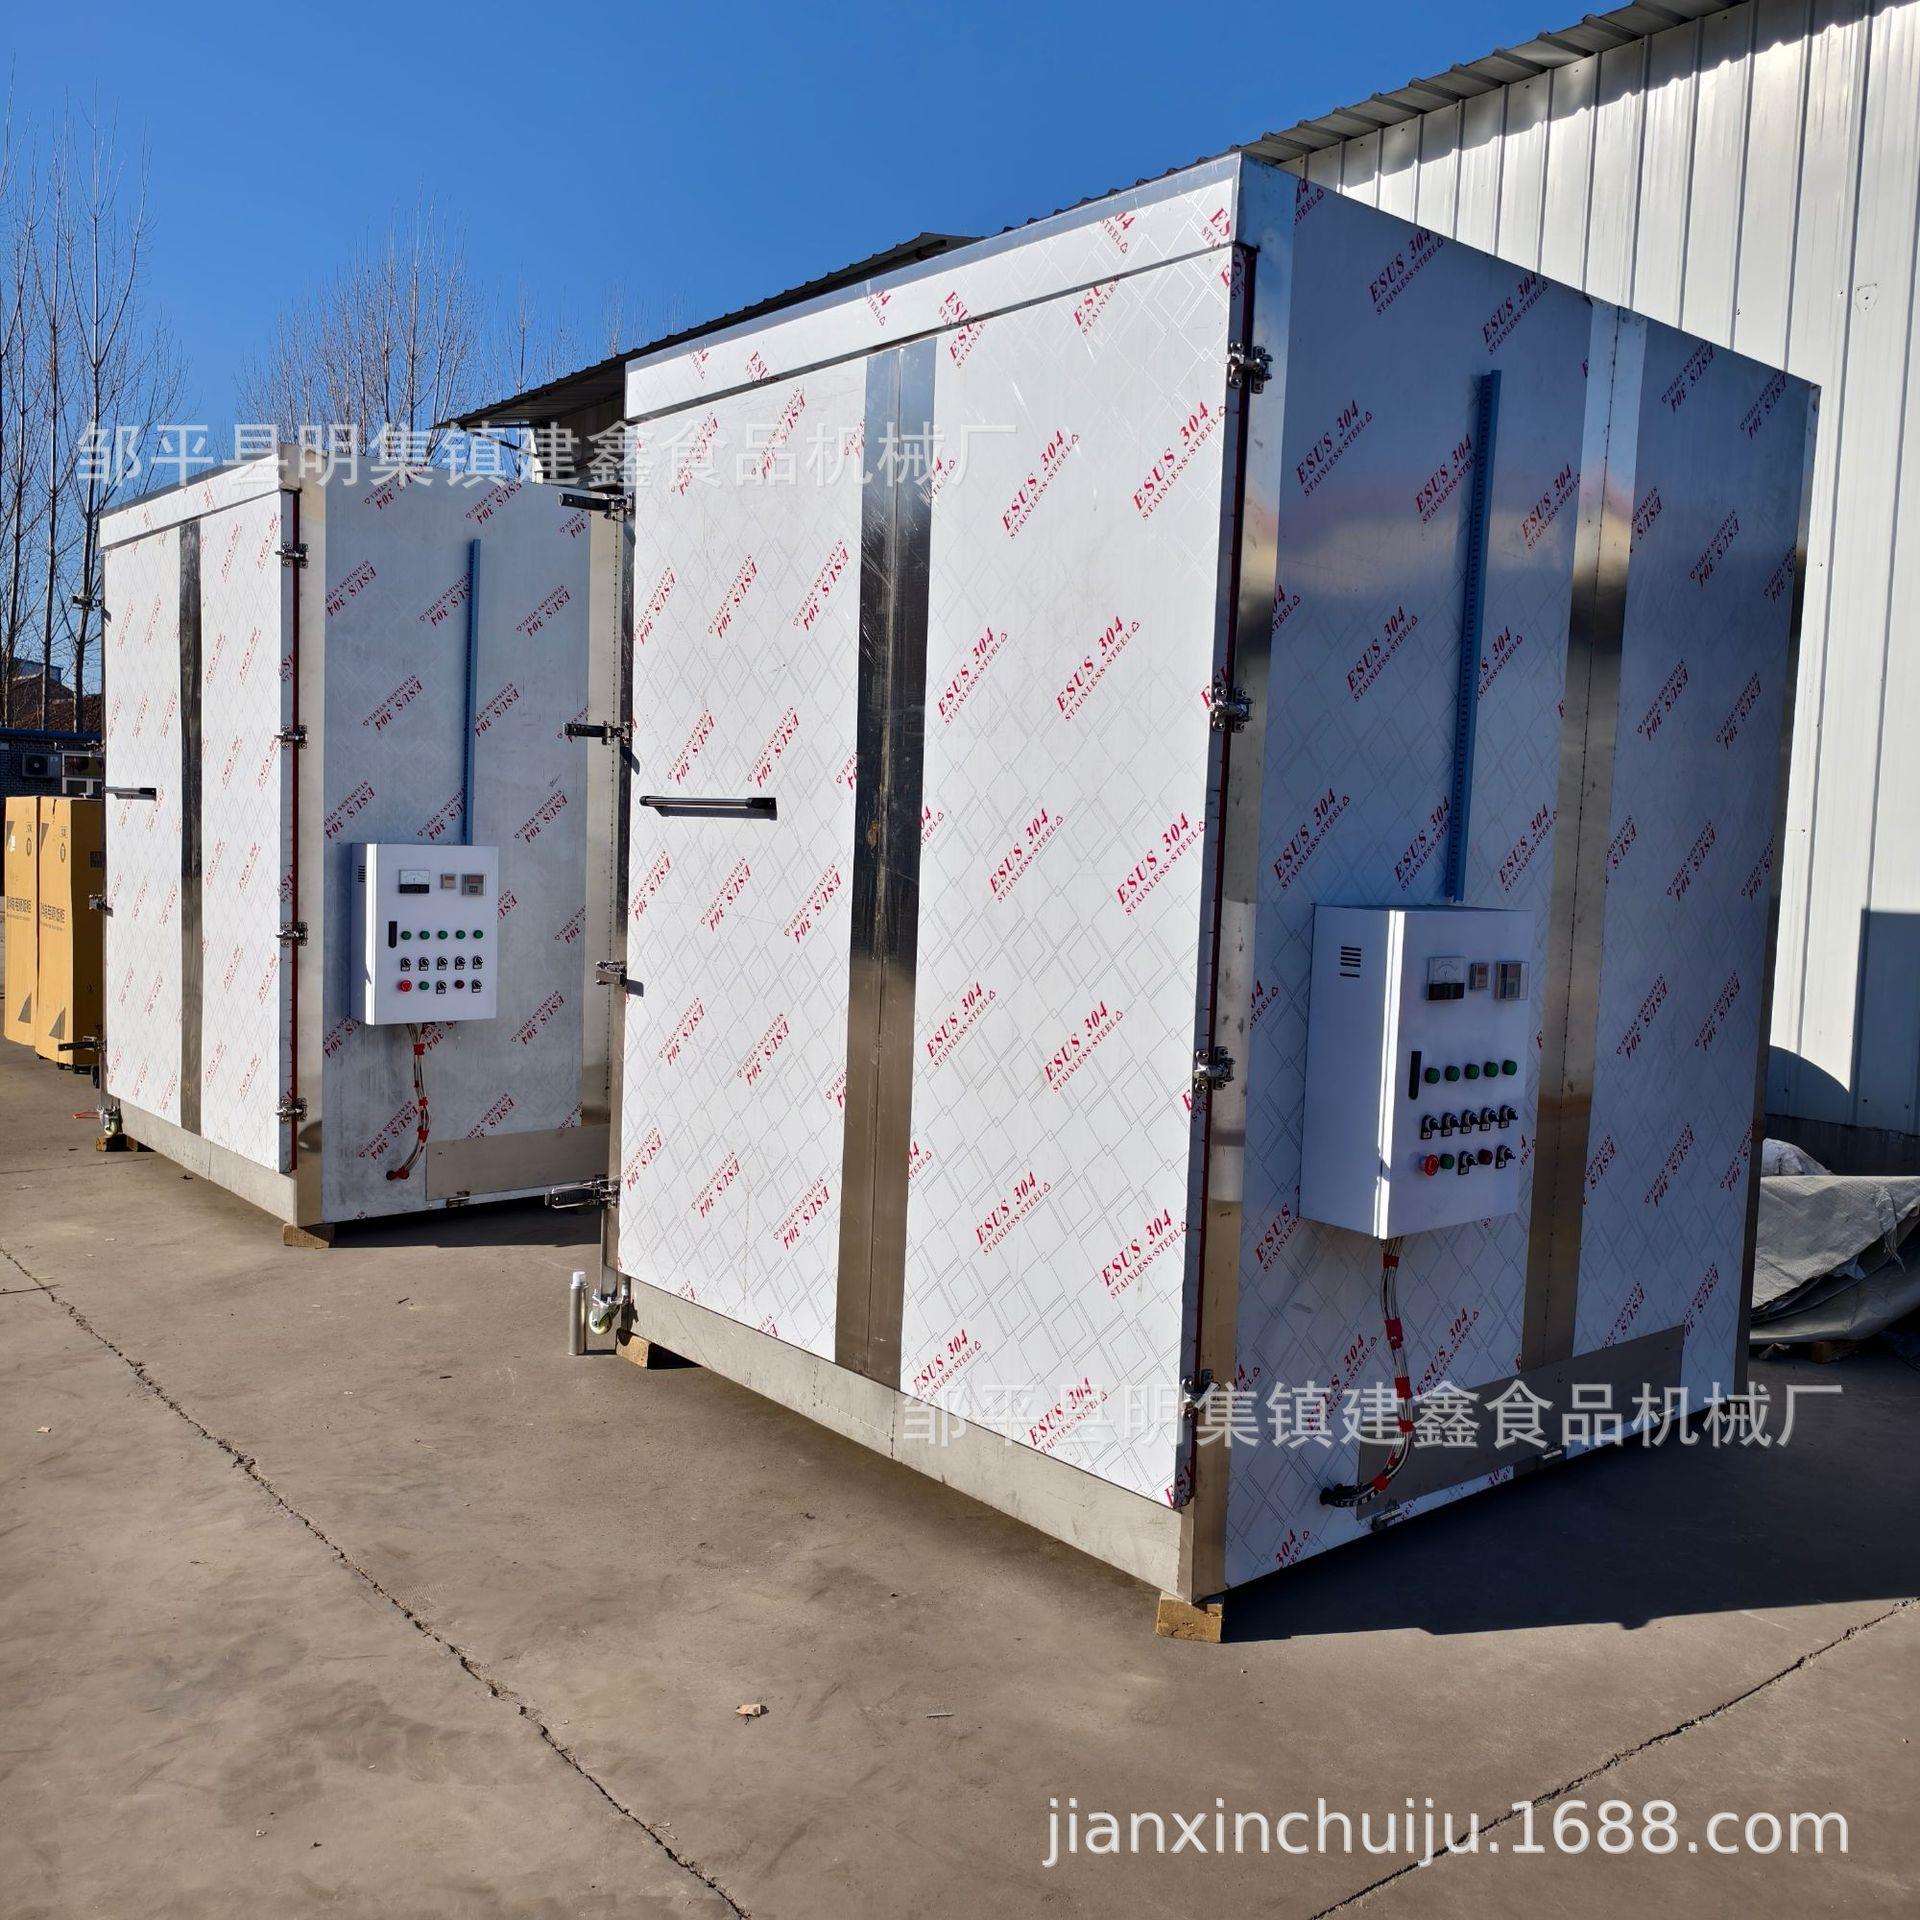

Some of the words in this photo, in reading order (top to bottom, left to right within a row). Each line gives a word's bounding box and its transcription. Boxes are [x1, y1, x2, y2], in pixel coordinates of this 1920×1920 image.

[1369, 254, 1404, 303] ESUS
[1408, 229, 1431, 258] 304
[1481, 296, 1514, 343] ESUS
[1517, 272, 1538, 303] 304
[1001, 472, 1038, 532] ESUS
[1039, 428, 1065, 472] 304
[1132, 448, 1175, 511] ESUS
[1176, 401, 1209, 445] 304
[1296, 433, 1332, 485] ESUS
[1336, 400, 1358, 437] 304
[1415, 465, 1449, 513] ESUS
[1452, 434, 1472, 467] 304
[1521, 493, 1550, 540] ESUS
[1554, 463, 1571, 495] 304
[936, 664, 970, 719] ESUS
[972, 627, 995, 665] 304
[1056, 656, 1095, 713] ESUS
[1099, 616, 1124, 656] 304
[1346, 640, 1380, 691] ESUS
[1383, 605, 1405, 642] 304
[988, 843, 1023, 894] ESUS
[1025, 808, 1049, 844] 304
[1117, 851, 1157, 904] ESUS
[1160, 813, 1189, 851] 304
[1272, 825, 1309, 881] ESUS
[1313, 788, 1336, 827] 304
[1393, 831, 1427, 882] ESUS
[1430, 797, 1450, 832] 304
[1499, 836, 1528, 885] ESUS
[1531, 804, 1549, 834] 304
[709, 905, 725, 932] 304
[794, 913, 812, 943] 304
[665, 1039, 681, 1066] 304
[763, 1020, 790, 1061] ESUS
[925, 1012, 958, 1058] ESUS
[961, 982, 983, 1015] 304
[1043, 1033, 1080, 1083] ESUS
[1084, 1002, 1108, 1036] 304
[745, 1058, 762, 1087] 304
[699, 1192, 715, 1219] 304
[716, 1159, 741, 1197] ESUS
[802, 1185, 830, 1226] ESUS
[975, 1200, 1008, 1246] ESUS
[1013, 1171, 1036, 1203] 304
[782, 1221, 801, 1250] 304
[1101, 1238, 1141, 1287] ESUS
[1146, 1209, 1172, 1245] 304
[913, 1353, 944, 1395] ESUS
[946, 1329, 969, 1360] 304
[1416, 1346, 1446, 1395] ESUS
[1450, 1304, 1467, 1337] 304
